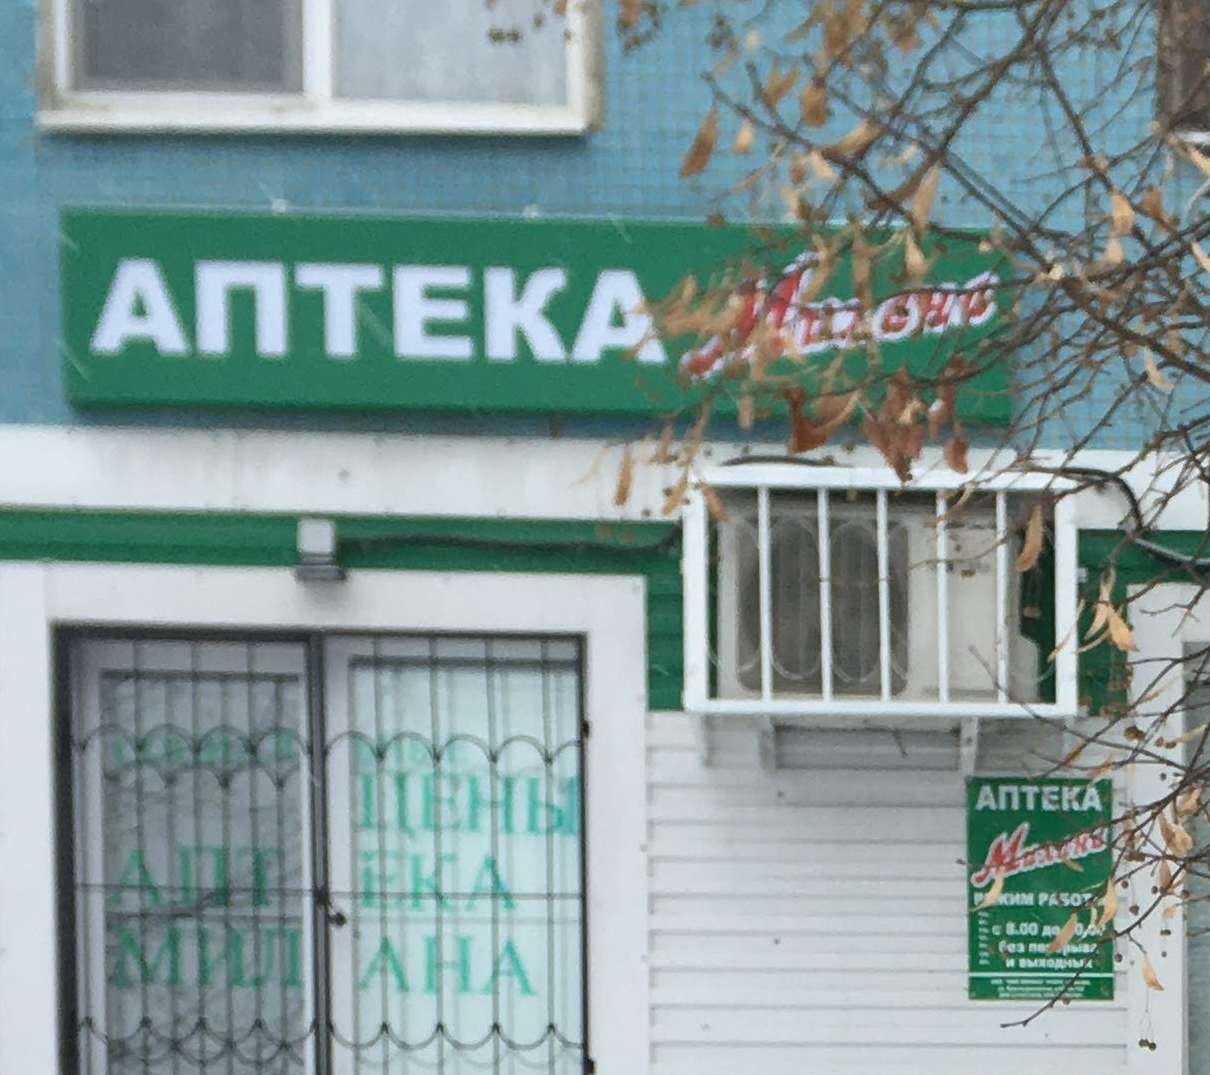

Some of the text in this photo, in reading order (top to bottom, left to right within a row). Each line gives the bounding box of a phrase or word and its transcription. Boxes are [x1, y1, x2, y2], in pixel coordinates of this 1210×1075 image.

[89, 256, 666, 366] АПТЕКА
[975, 784, 1103, 812] АПТЕКА
[973, 892, 1108, 908] РЖИМ РАБОТ
